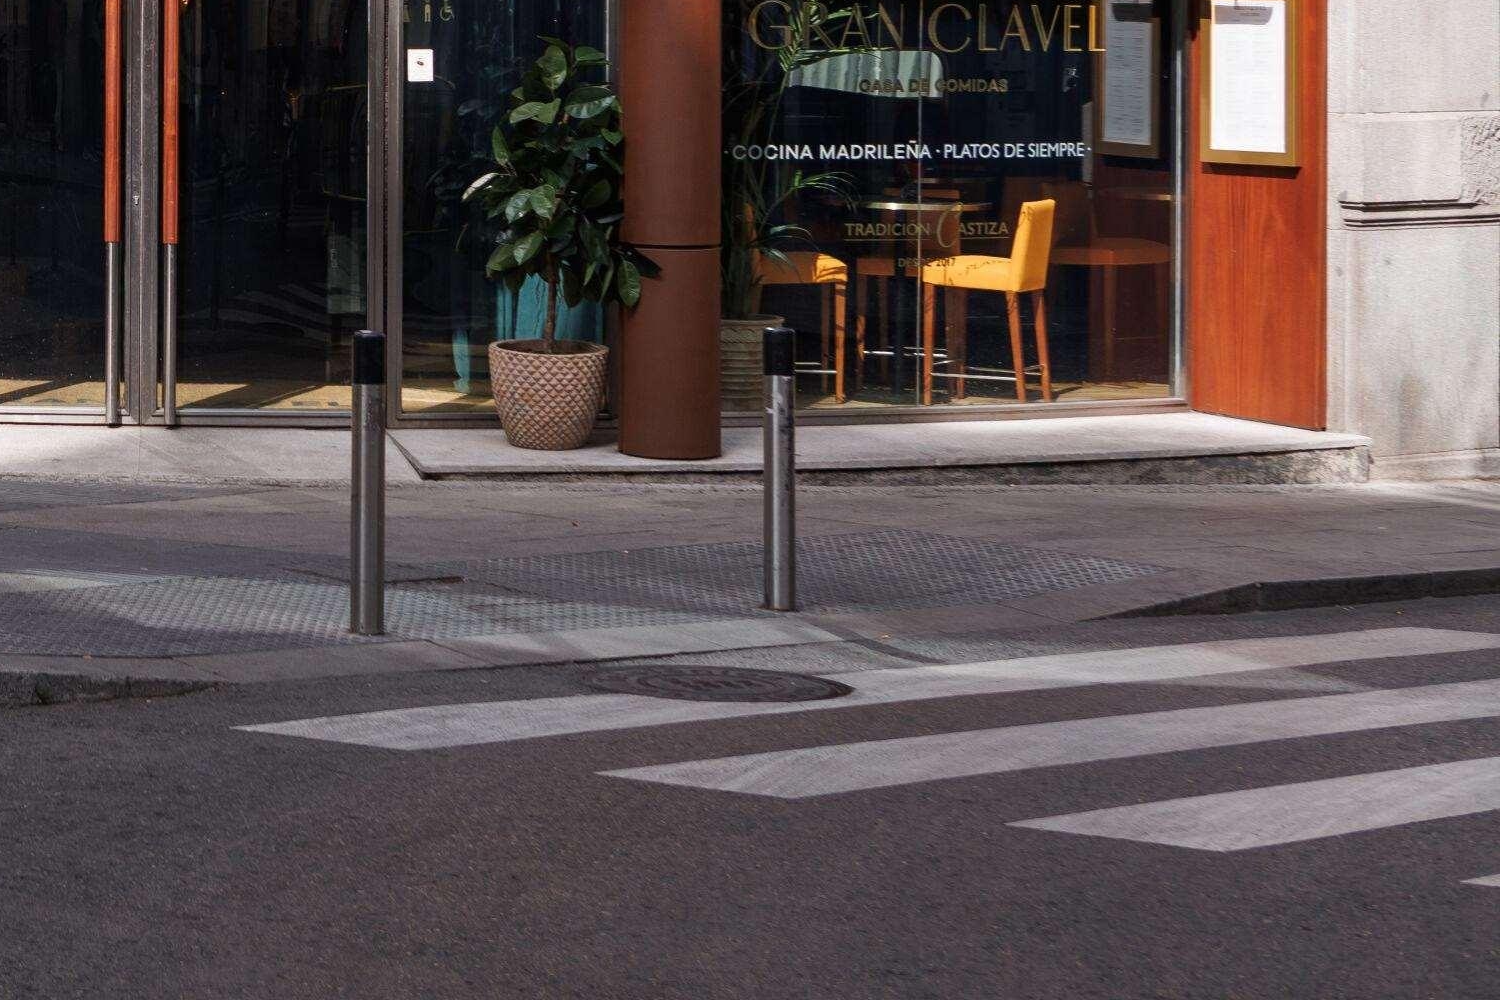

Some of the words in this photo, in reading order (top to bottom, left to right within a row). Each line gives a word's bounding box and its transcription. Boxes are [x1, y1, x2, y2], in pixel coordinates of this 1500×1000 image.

[748, 0, 904, 51] GRAN
[927, 3, 1107, 53] CLAVEL
[858, 78, 904, 93] CASA
[909, 79, 930, 94] DE
[935, 78, 1009, 93] COMIDAS
[733, 144, 814, 161] COCINA
[819, 140, 932, 161] MADRILEÑA
[943, 143, 1000, 159] PLATOS
[1003, 143, 1025, 159] DE
[1028, 142, 1086, 158] SIEMPRE
